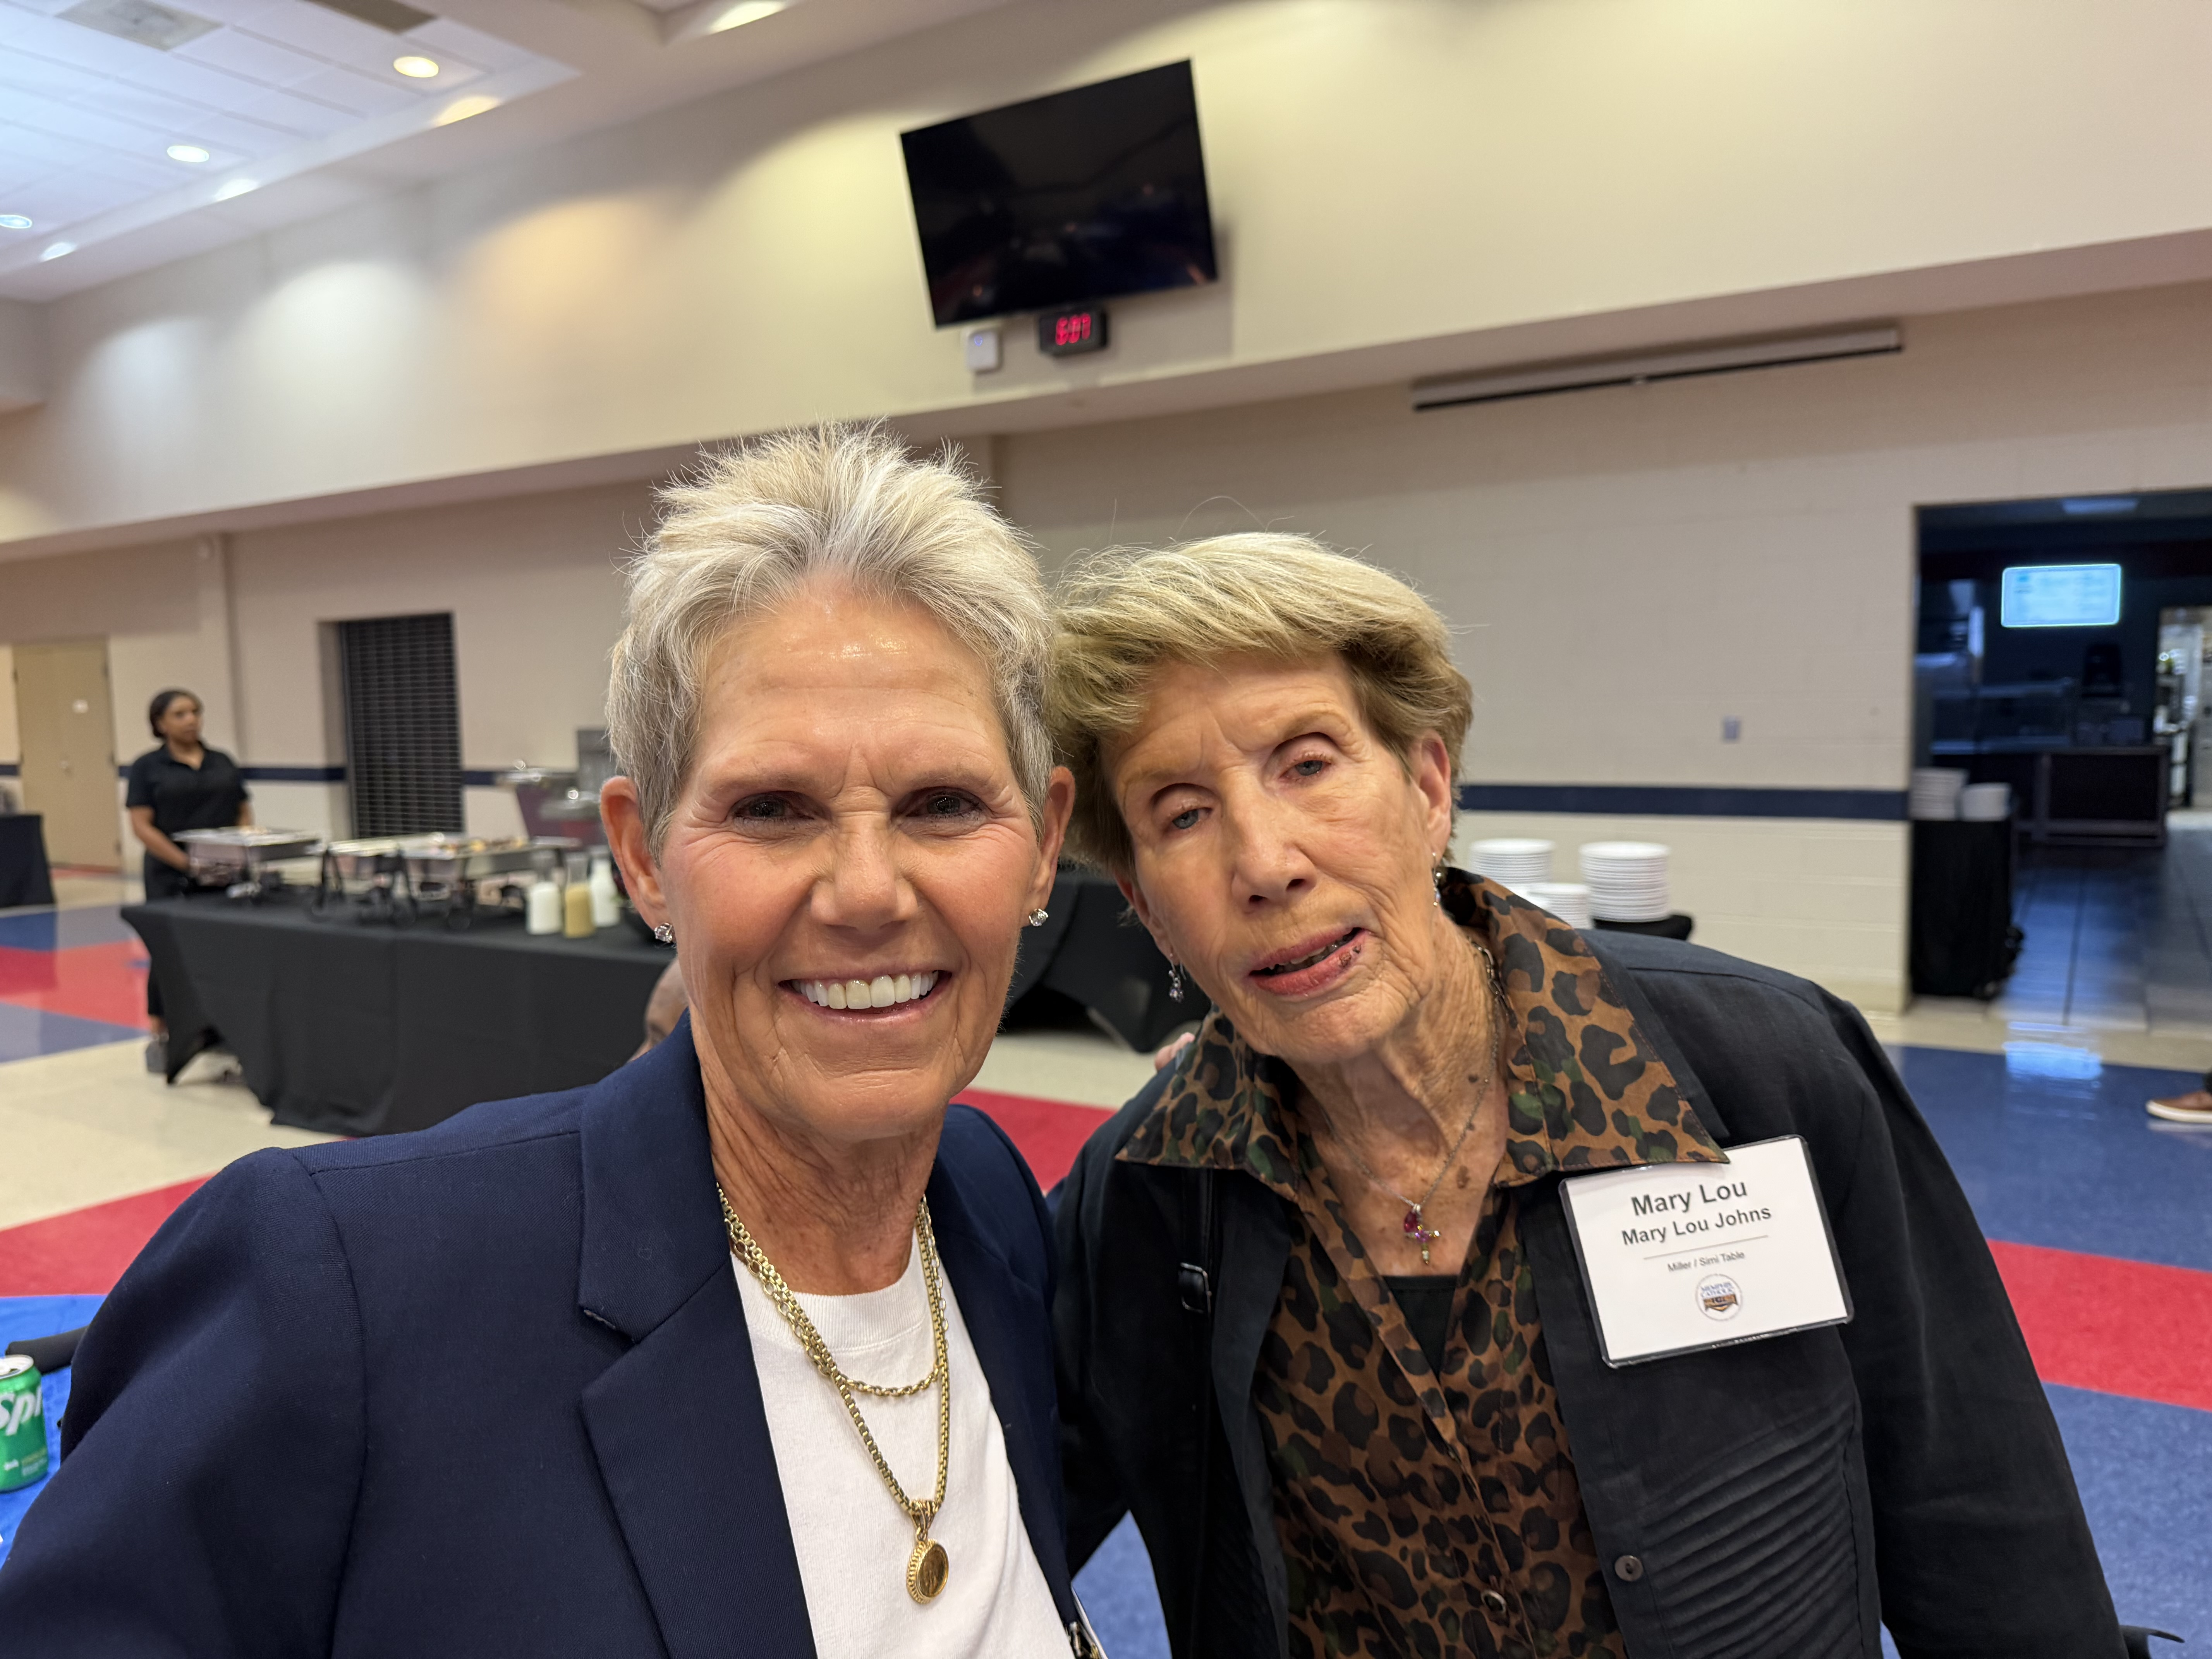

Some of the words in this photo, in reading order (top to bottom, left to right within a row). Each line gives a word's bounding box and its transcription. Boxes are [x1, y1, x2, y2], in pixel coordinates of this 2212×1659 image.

[1631, 1192, 1691, 1216] Mary
[1699, 1181, 1747, 1203] Lou
[1622, 1226, 1666, 1245] Mary
[1673, 1219, 1709, 1235] Lou
[1715, 1207, 1771, 1228] Johns
[1668, 1262, 1691, 1272] Miller
[1721, 1251, 1745, 1262] Table
